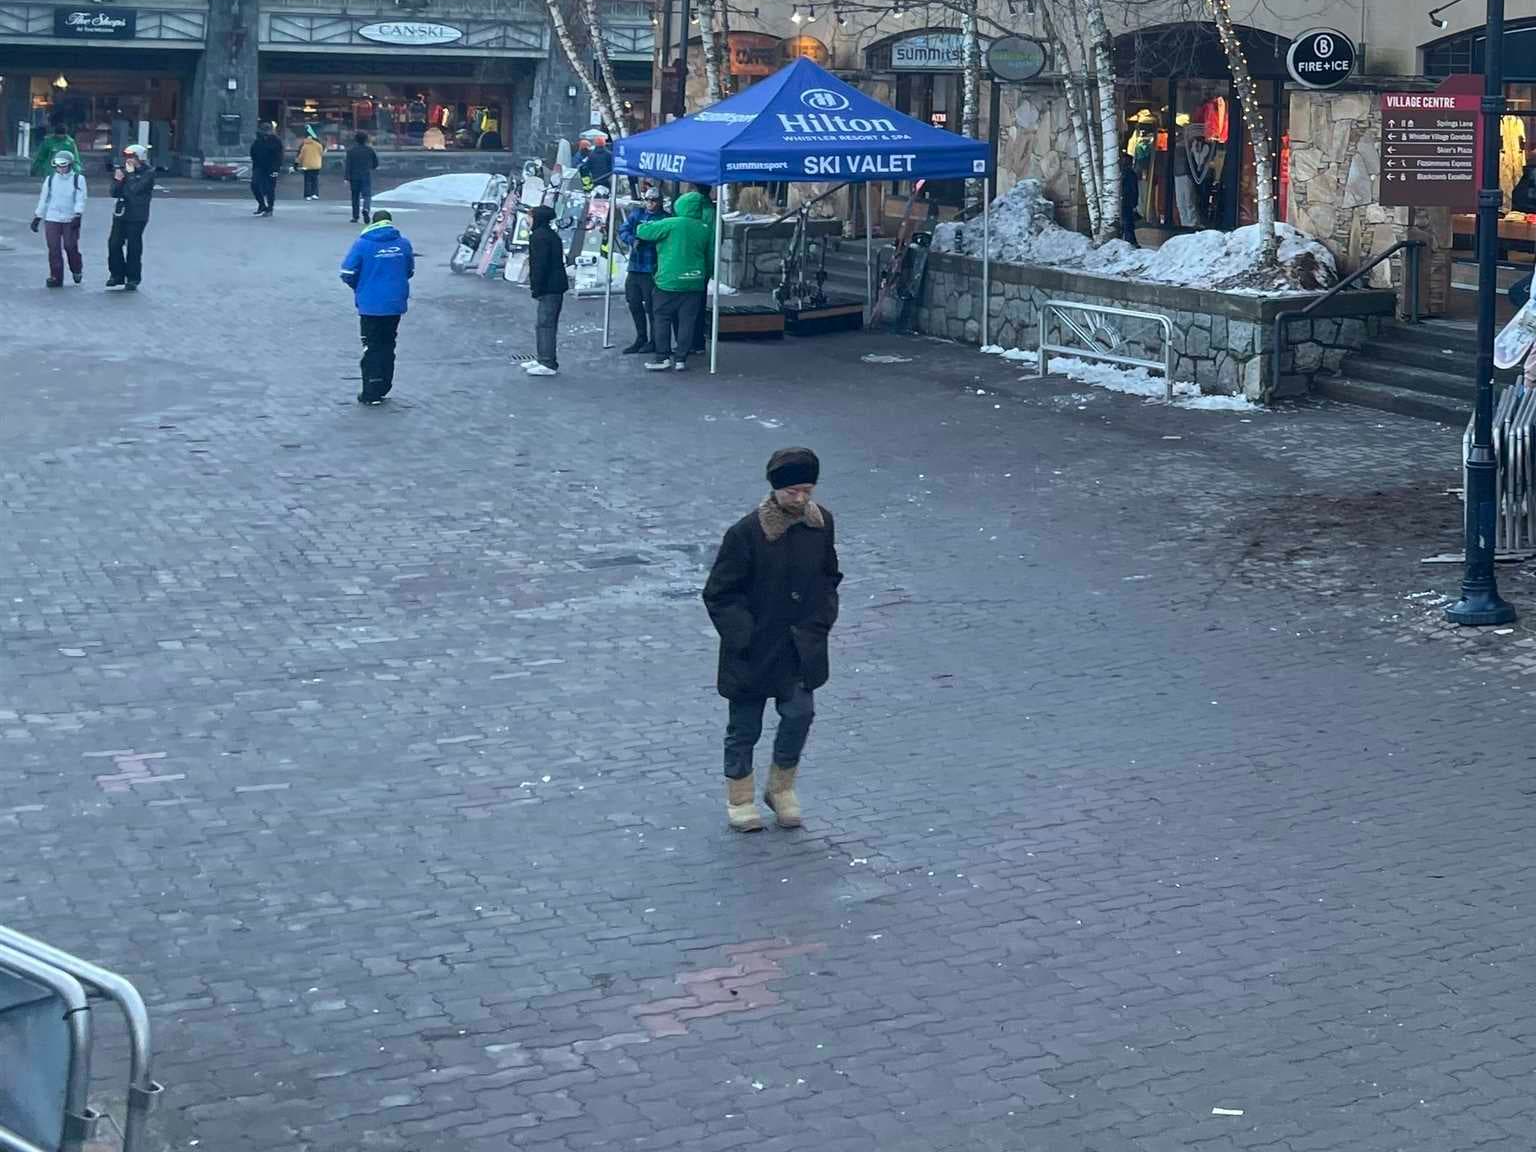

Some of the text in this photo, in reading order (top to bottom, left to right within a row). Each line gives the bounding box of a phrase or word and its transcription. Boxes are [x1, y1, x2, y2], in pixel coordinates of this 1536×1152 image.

[1298, 60, 1350, 73] FIRE+ICE
[1386, 96, 1456, 108] VILLAGE CENTRE
[776, 113, 898, 133] Hilton
[639, 151, 655, 170] SKI
[655, 153, 687, 173] VALET
[803, 154, 916, 175] SKI VALET
